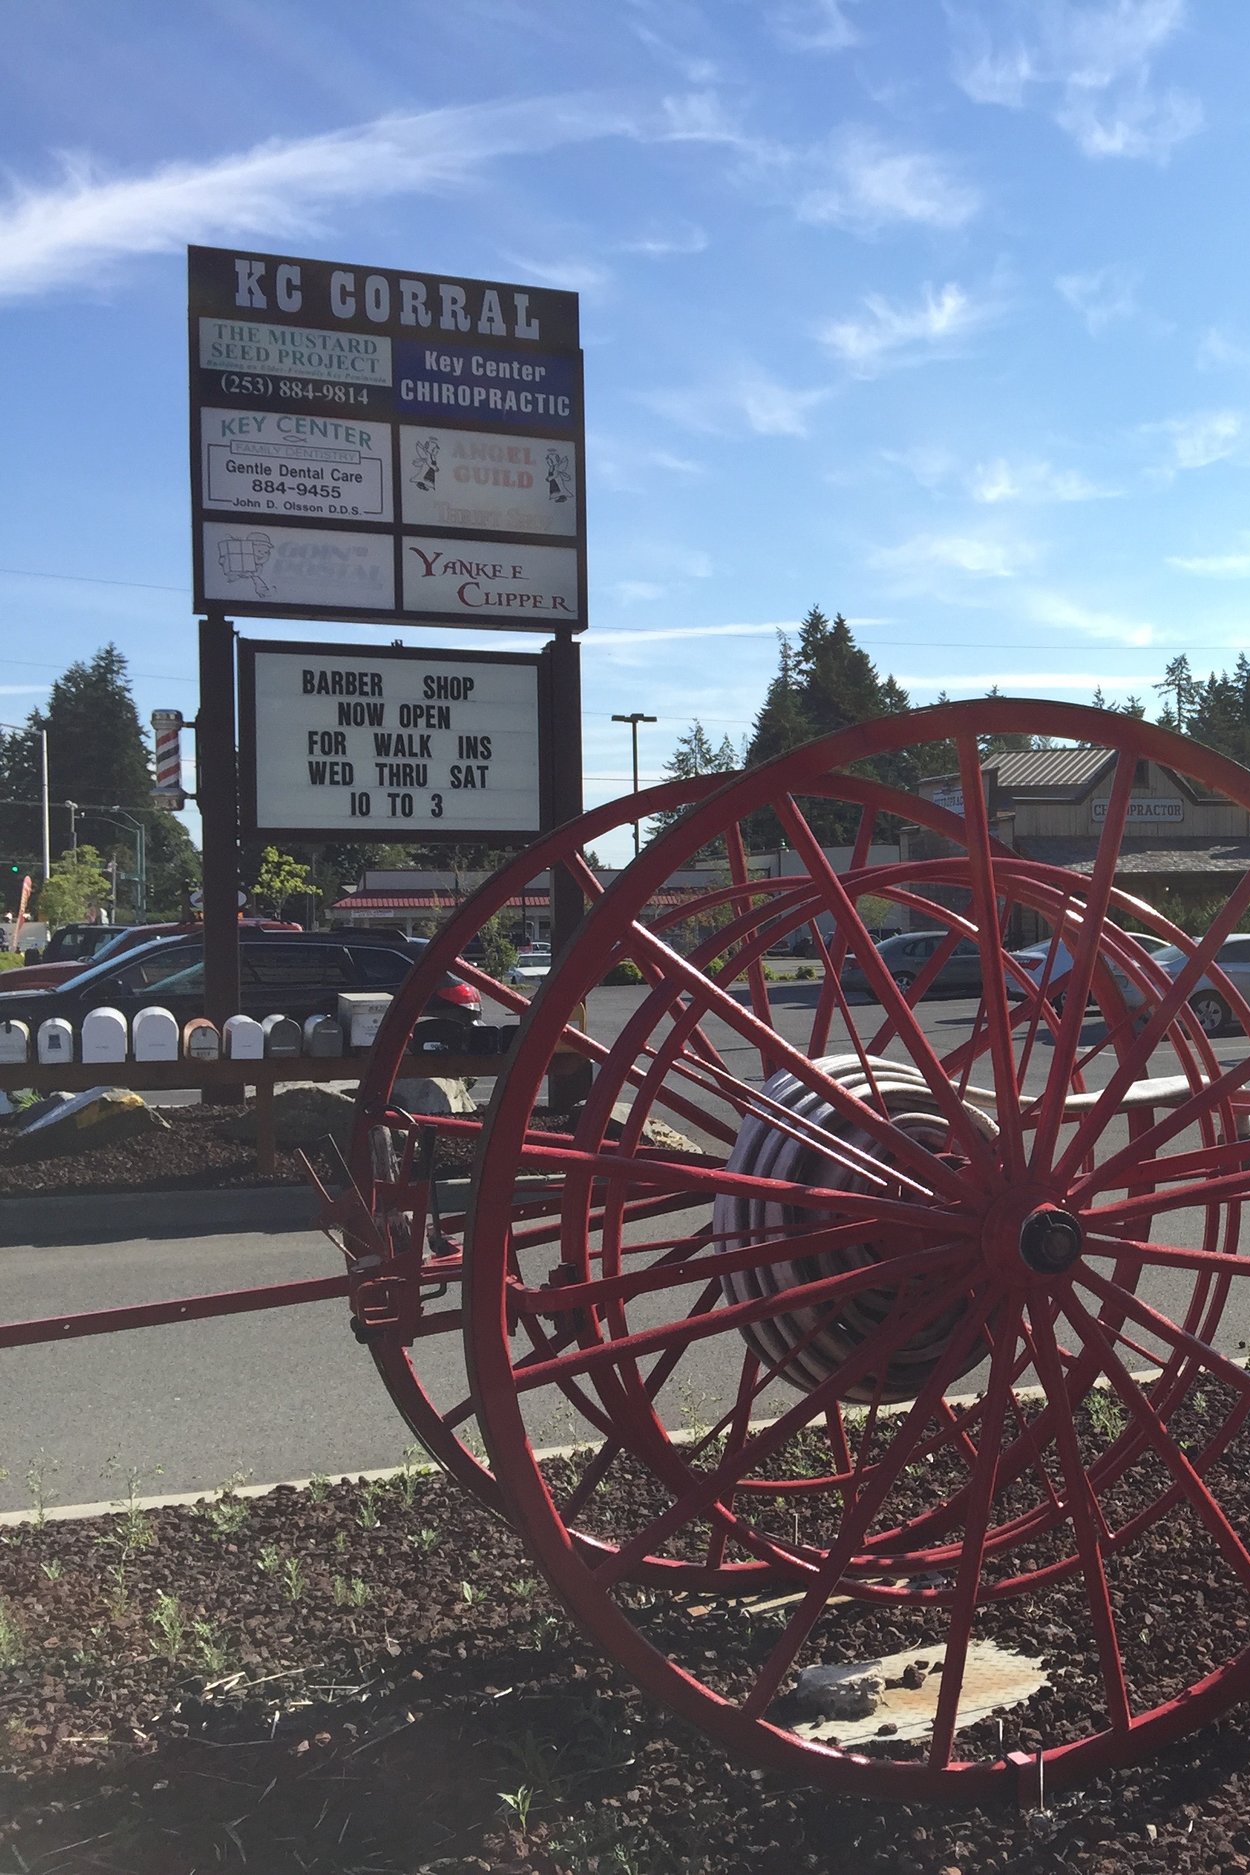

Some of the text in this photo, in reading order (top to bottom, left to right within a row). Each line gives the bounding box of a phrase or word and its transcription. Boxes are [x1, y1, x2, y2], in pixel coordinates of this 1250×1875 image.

[234, 258, 540, 341] KC CORRAL
[213, 323, 378, 355] THE MUSTARD
[211, 342, 380, 374] SEED PROJECT
[424, 350, 547, 383] Key Center
[221, 373, 369, 405] (253) 884-9814
[401, 378, 571, 418] CHIROPRACTIC
[221, 415, 373, 450] KEY CENTER
[285, 447, 355, 462] DENTISTRY
[452, 440, 537, 466] ANGEL
[225, 459, 363, 484] Gentle Dental Care
[453, 464, 535, 489] GUILD
[251, 479, 342, 499] 884-9455
[232, 497, 362, 516] John D. Olsson D.D.S.
[409, 546, 530, 580] YANKEE
[457, 581, 576, 613] CLIPPER
[302, 669, 475, 701] BARBER SHOP
[338, 702, 451, 730] NOW OPEN
[307, 731, 492, 760] FOR WALK INS
[308, 761, 489, 789] WED THRU SAT
[350, 792, 443, 818] 10 TO 3
